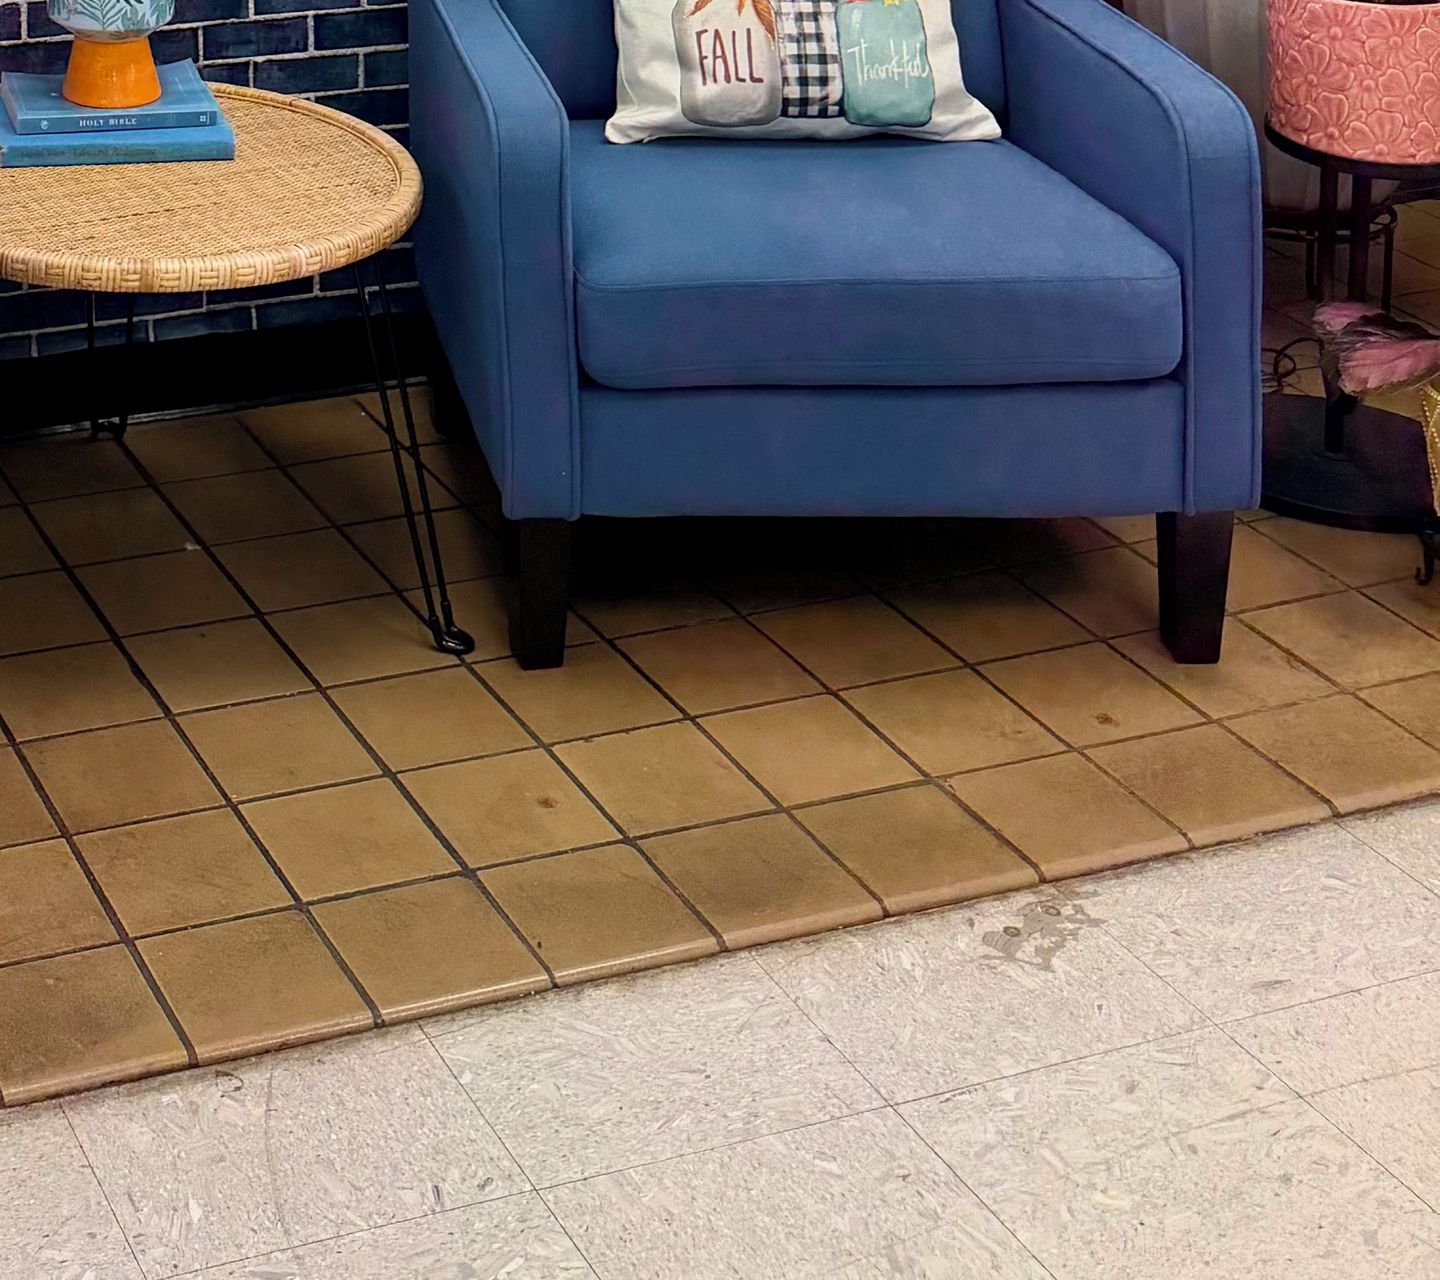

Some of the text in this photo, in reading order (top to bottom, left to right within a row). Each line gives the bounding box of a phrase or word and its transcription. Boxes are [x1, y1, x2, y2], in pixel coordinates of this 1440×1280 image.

[695, 27, 764, 86] FALL
[848, 39, 931, 89] Thankful
[79, 116, 138, 128] HOLY BIBLE
